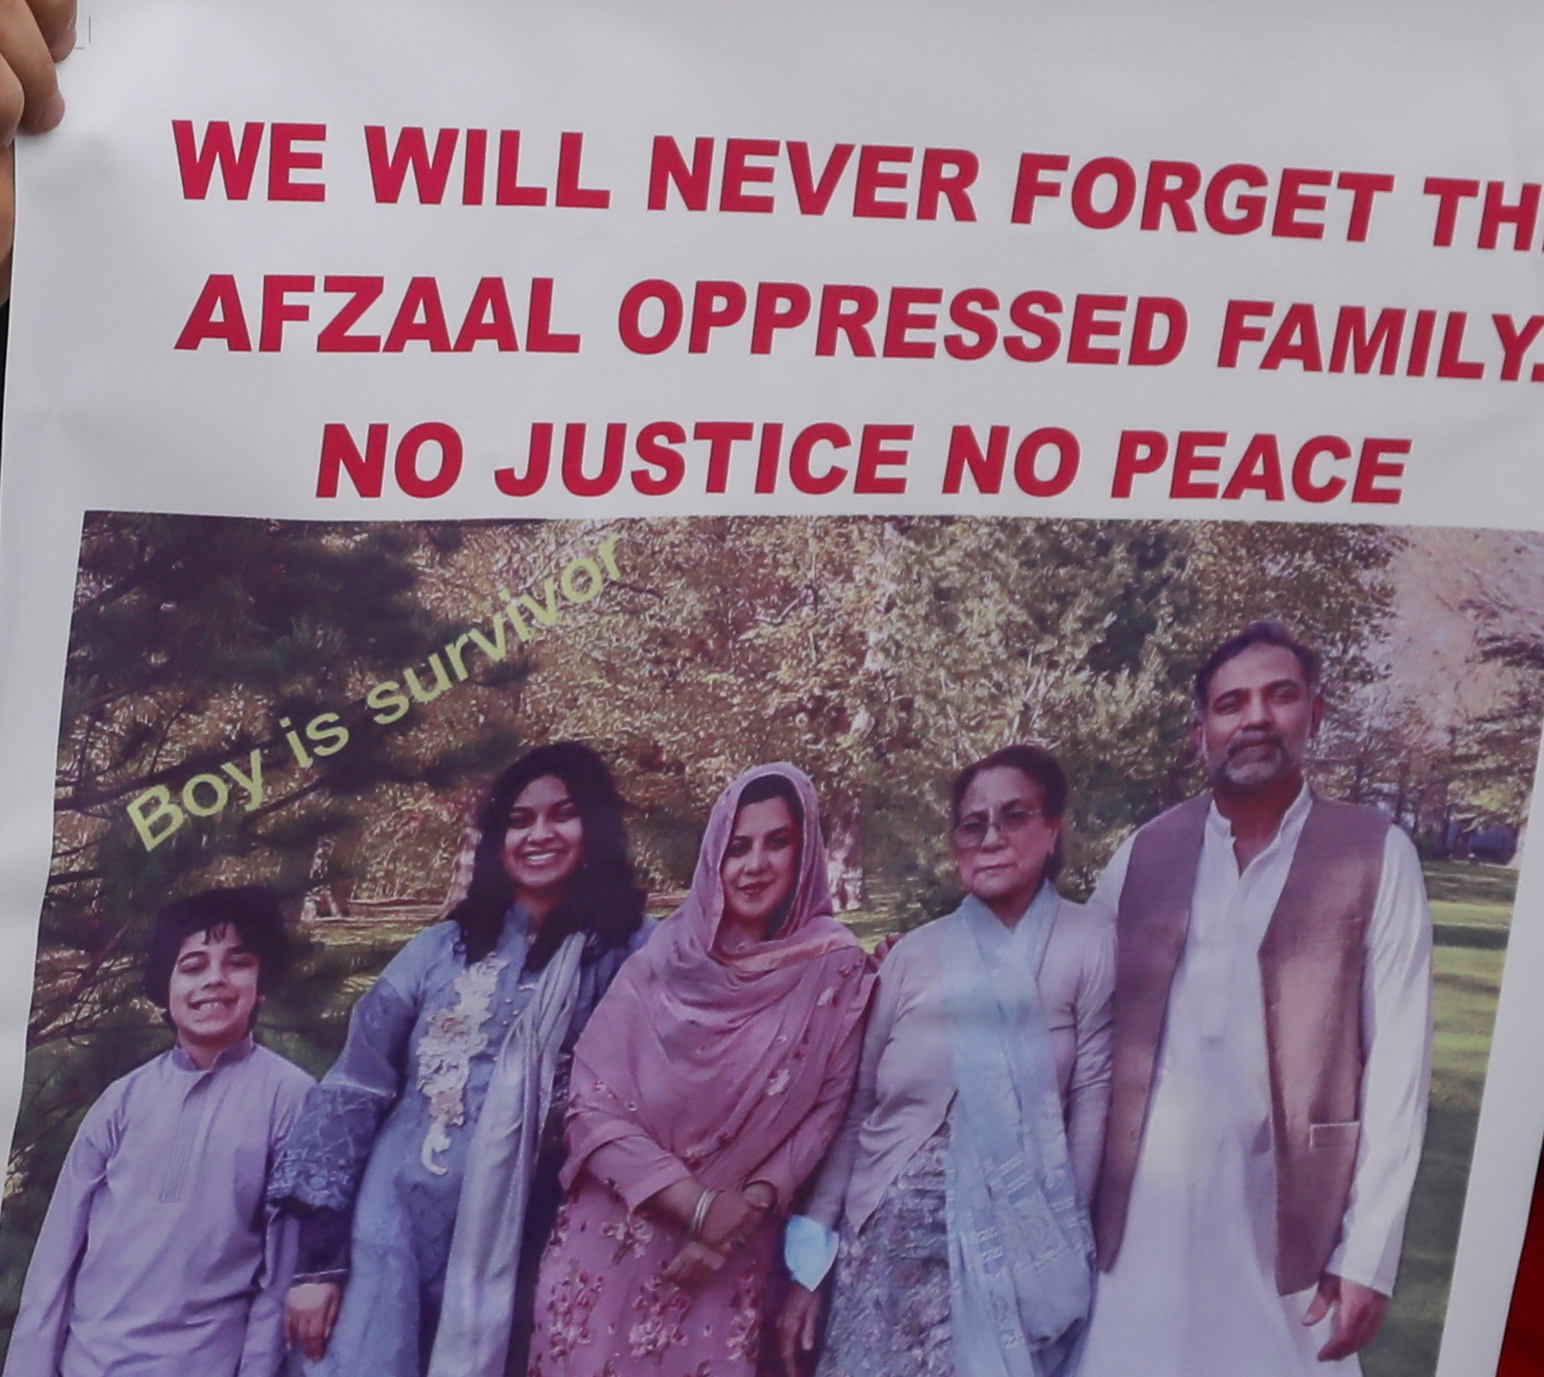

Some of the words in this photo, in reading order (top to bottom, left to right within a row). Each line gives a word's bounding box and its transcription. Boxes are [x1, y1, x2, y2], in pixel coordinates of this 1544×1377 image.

[173, 121, 325, 201] WE
[365, 126, 609, 208] WILL
[648, 136, 978, 221] NEVER
[1012, 154, 1393, 241] FORGET
[175, 275, 580, 353] AFZAAL
[619, 280, 1187, 365] OPPRESSED
[317, 423, 462, 498] NO
[495, 422, 913, 496] JUSTICE
[943, 426, 1079, 497] NO
[1112, 431, 1410, 509] PEACE
[125, 749, 264, 852] Boy
[279, 710, 350, 769] is
[366, 530, 622, 725] survivor
